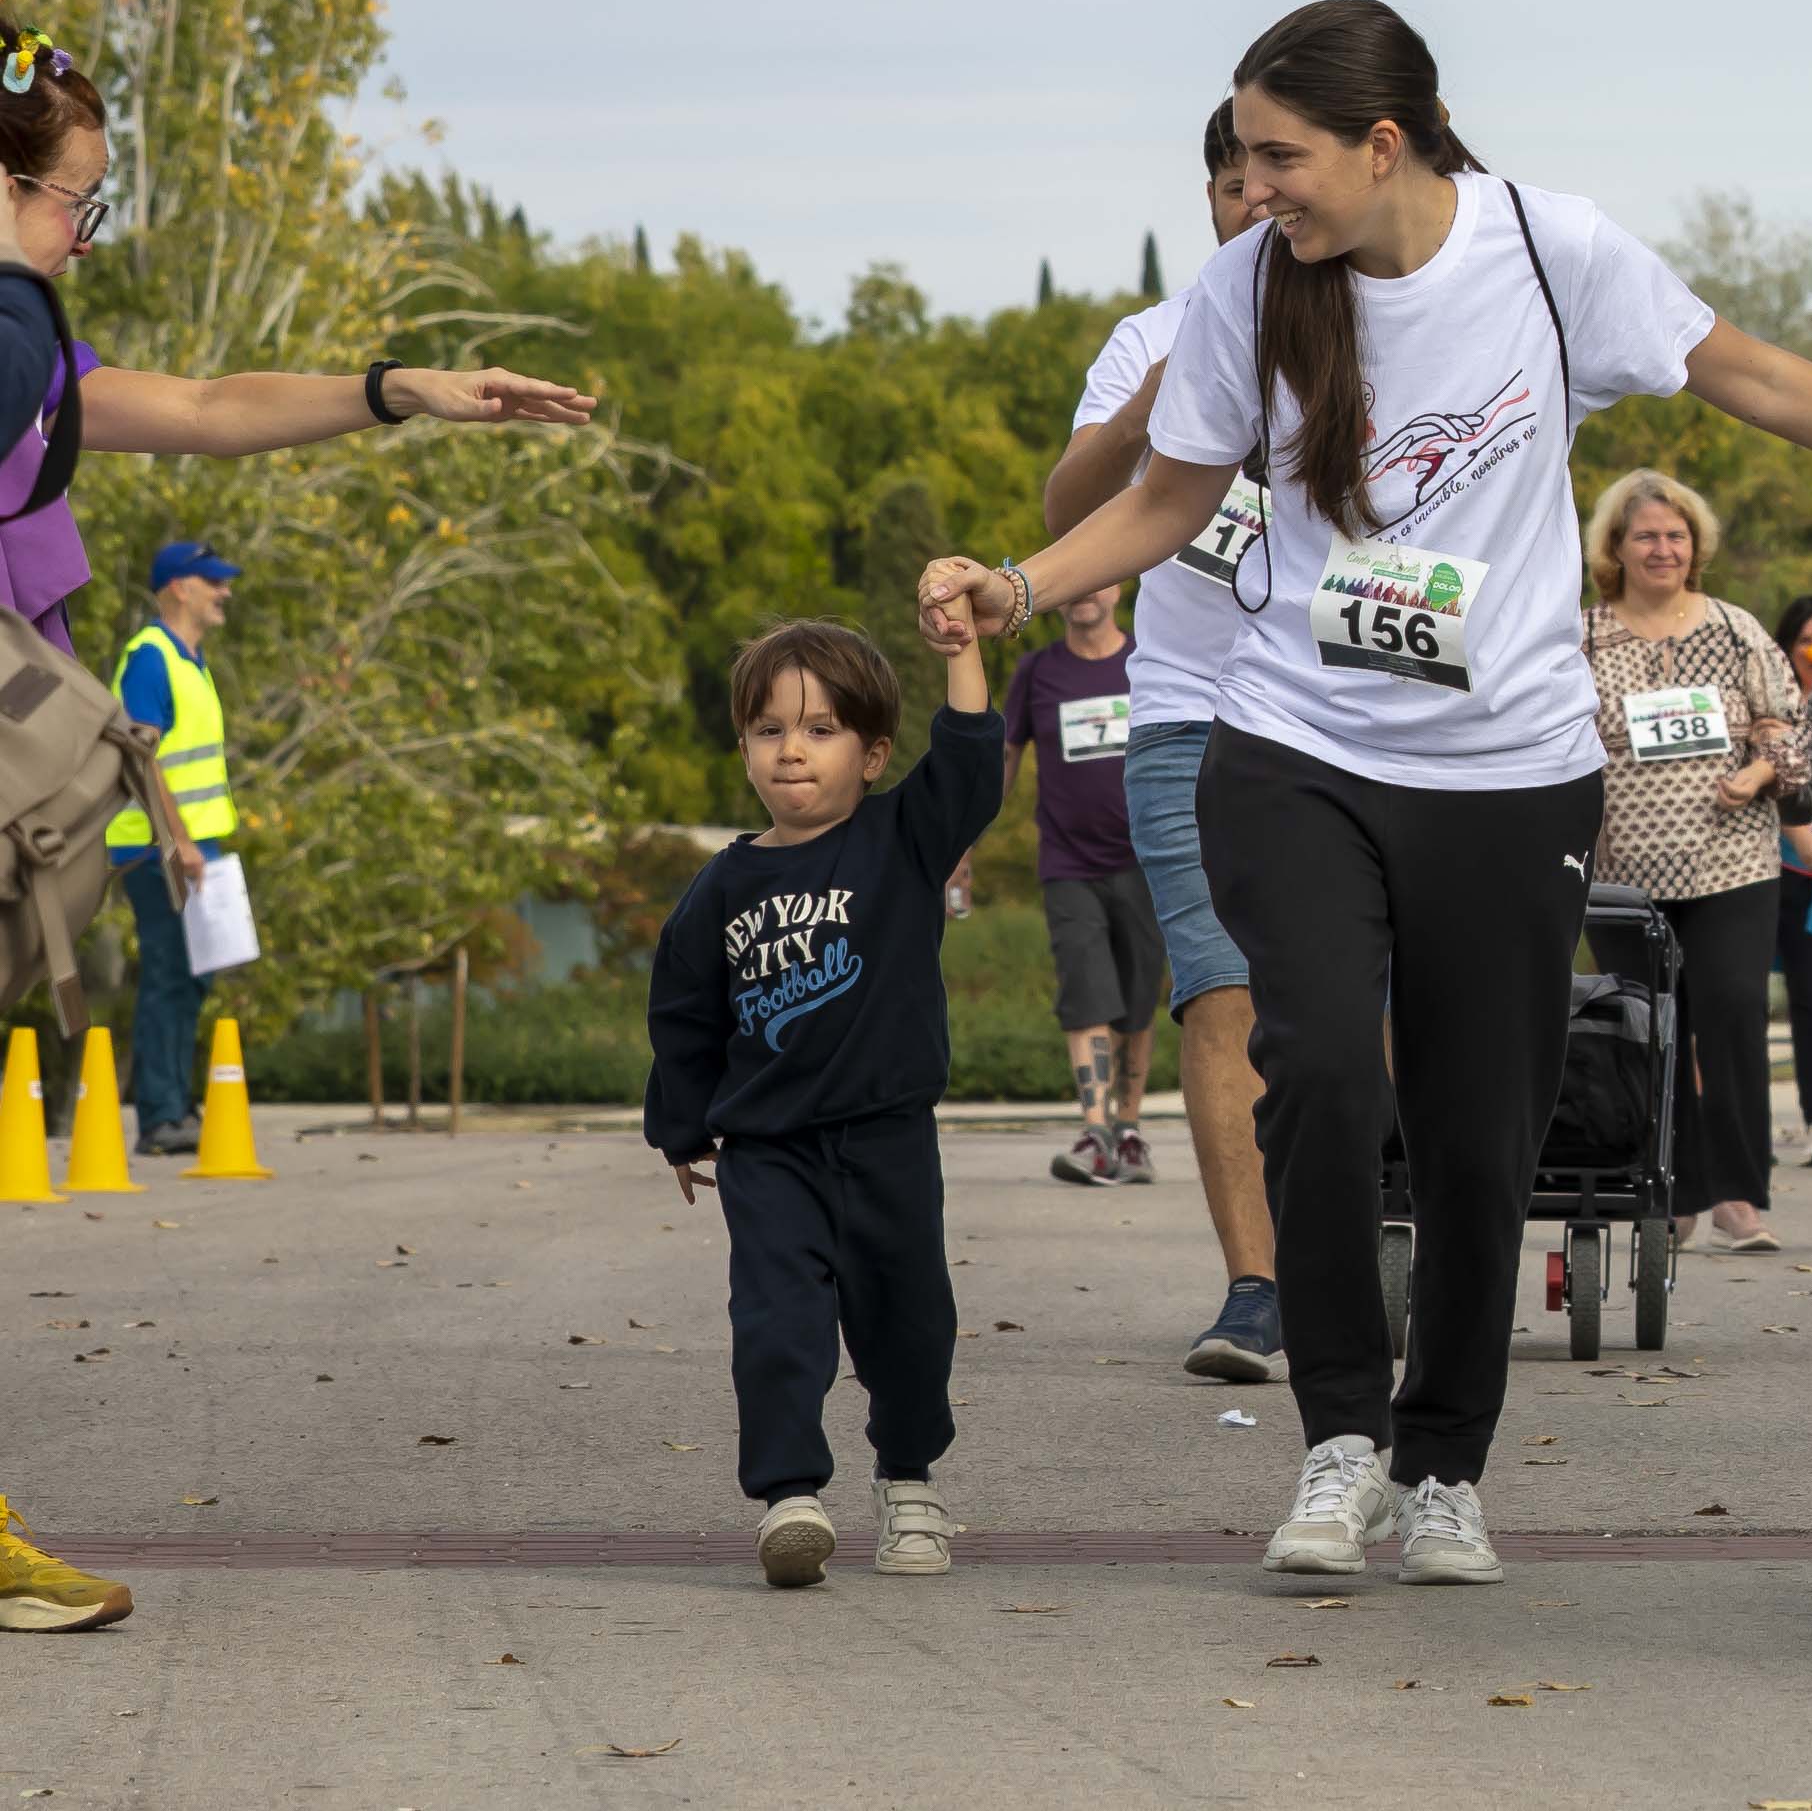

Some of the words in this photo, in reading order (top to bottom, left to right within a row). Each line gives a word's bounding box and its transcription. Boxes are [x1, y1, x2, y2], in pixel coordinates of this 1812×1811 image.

[1399, 523, 1413, 538] es
[1470, 438, 1521, 481] nosotros
[1522, 424, 1538, 442] no
[1432, 581, 1461, 592] DOLOR
[1339, 599, 1440, 660] 156
[1093, 722, 1107, 743] 7
[1648, 716, 1710, 742] 138
[724, 899, 768, 967] NEW
[741, 928, 816, 981] CITY
[735, 937, 857, 1037] Football
